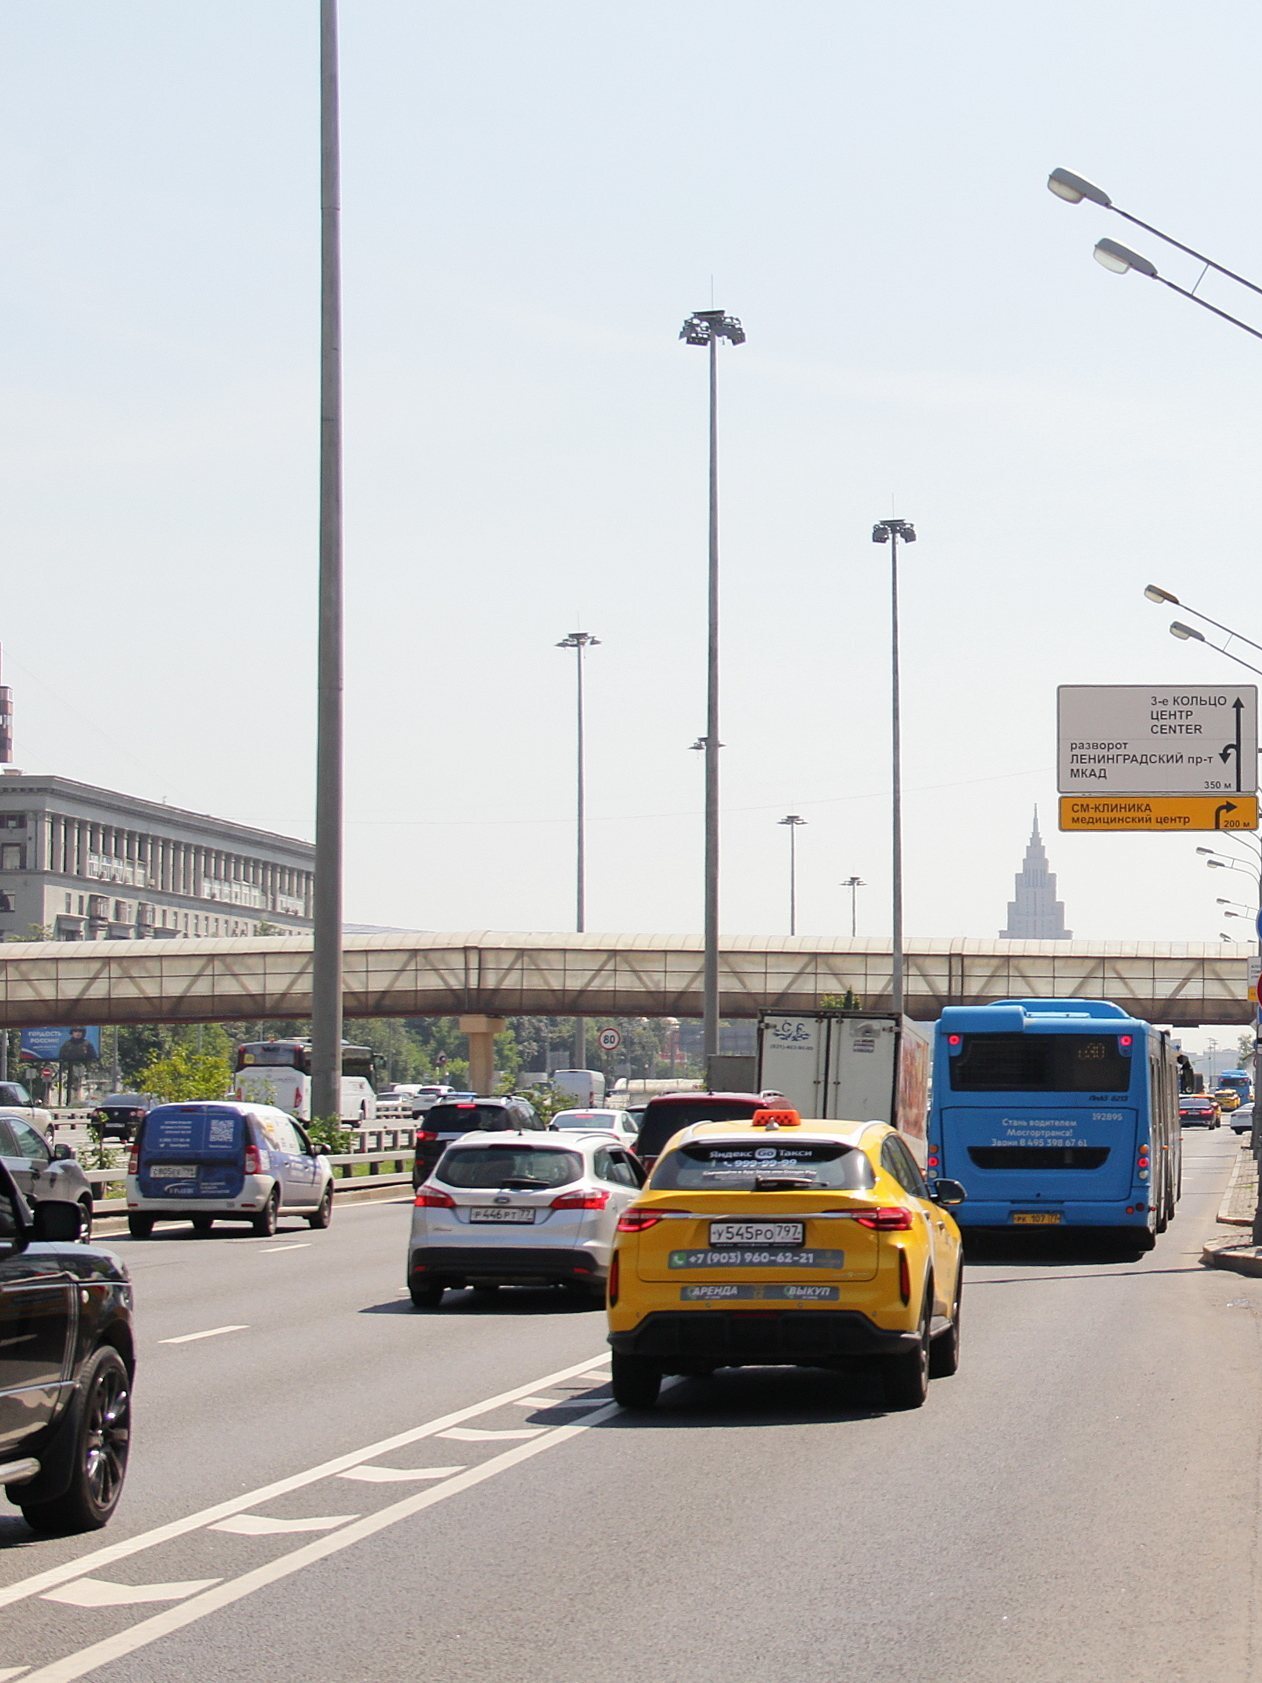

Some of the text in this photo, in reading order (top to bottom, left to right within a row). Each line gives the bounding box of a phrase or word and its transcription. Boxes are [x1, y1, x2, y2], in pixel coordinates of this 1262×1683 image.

[1151, 696, 1227, 708] 3-е КОЛЬЦО
[1150, 711, 1193, 722] ЦЕНТР
[1150, 724, 1203, 735] CENTER
[1070, 741, 1128, 752] разворот
[1070, 752, 1213, 765] ЛЕНИНГРАДСКИЙ пр-т
[1070, 768, 1107, 780] МКАД
[1204, 781, 1221, 789] 350
[1071, 803, 1152, 813] СМ-КЛИНИКА
[1071, 814, 1191, 826] медицинский центр
[1223, 820, 1240, 828] 200
[1002, 1118, 1027, 1126] Стань
[1006, 1129, 1073, 1137] Мосгортранса!
[779, 1149, 813, 1157] Такси
[734, 1158, 797, 1168] 999-99-99
[688, 1251, 814, 1264] +7 (903) 960-62-21
[693, 1286, 738, 1296] АРЕНДА
[789, 1286, 831, 1296] ВЫКУП
